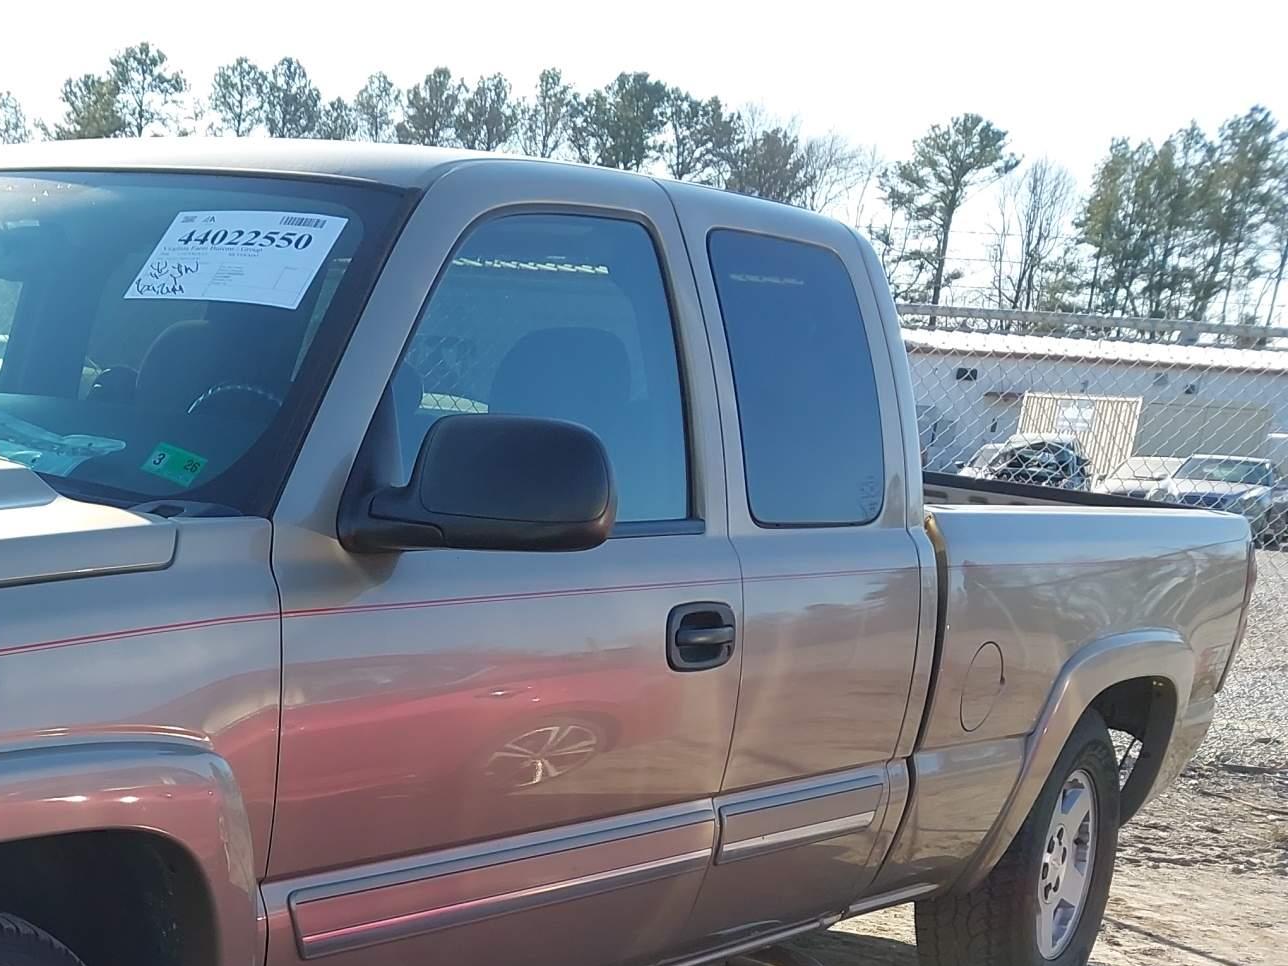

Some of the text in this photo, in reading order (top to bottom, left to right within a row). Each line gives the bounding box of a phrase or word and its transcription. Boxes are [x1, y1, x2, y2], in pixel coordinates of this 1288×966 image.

[178, 229, 313, 250] 44022550
[153, 453, 201, 473] 3 26
